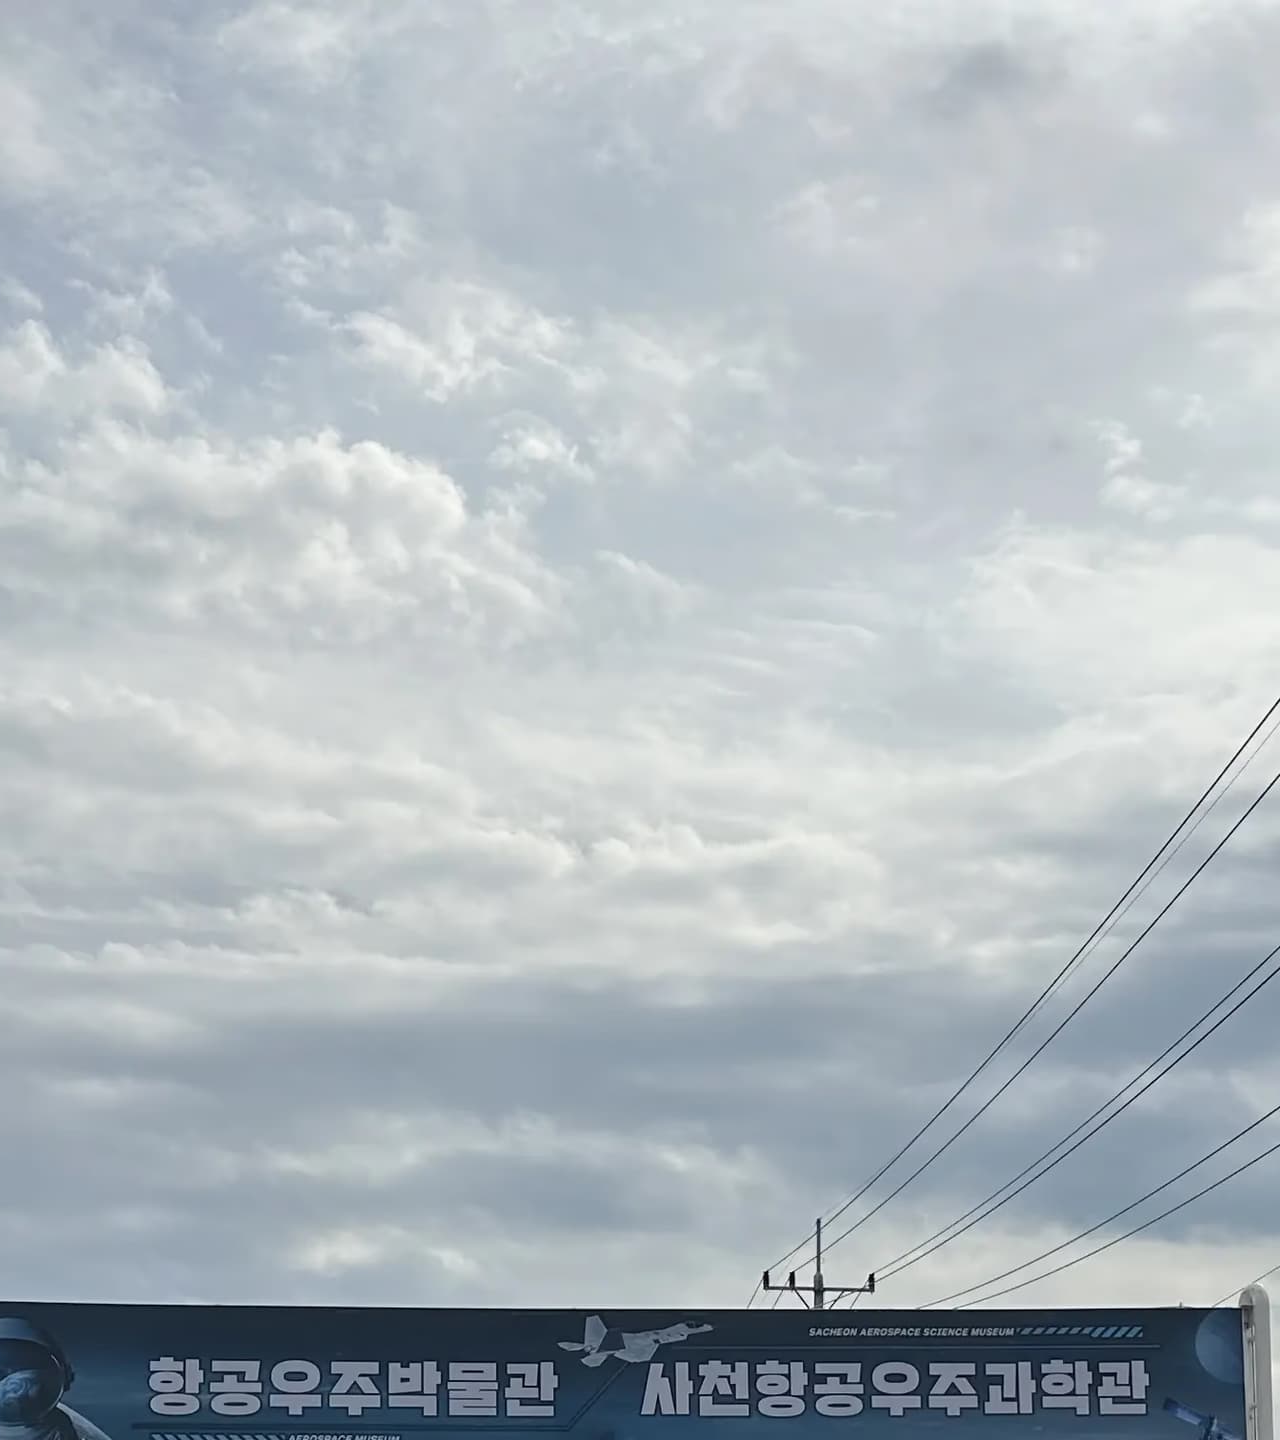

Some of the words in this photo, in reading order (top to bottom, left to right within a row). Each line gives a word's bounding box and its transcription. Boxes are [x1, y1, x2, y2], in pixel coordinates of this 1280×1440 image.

[808, 1327, 858, 1337] SACHEON
[859, 1327, 921, 1337] AEROSPACE
[922, 1327, 969, 1337] SCIENCE
[970, 1327, 1015, 1337] MUSEUM
[147, 1357, 560, 1418] 항공우주박물관
[639, 1359, 1150, 1417] 사천항공우주과학관
